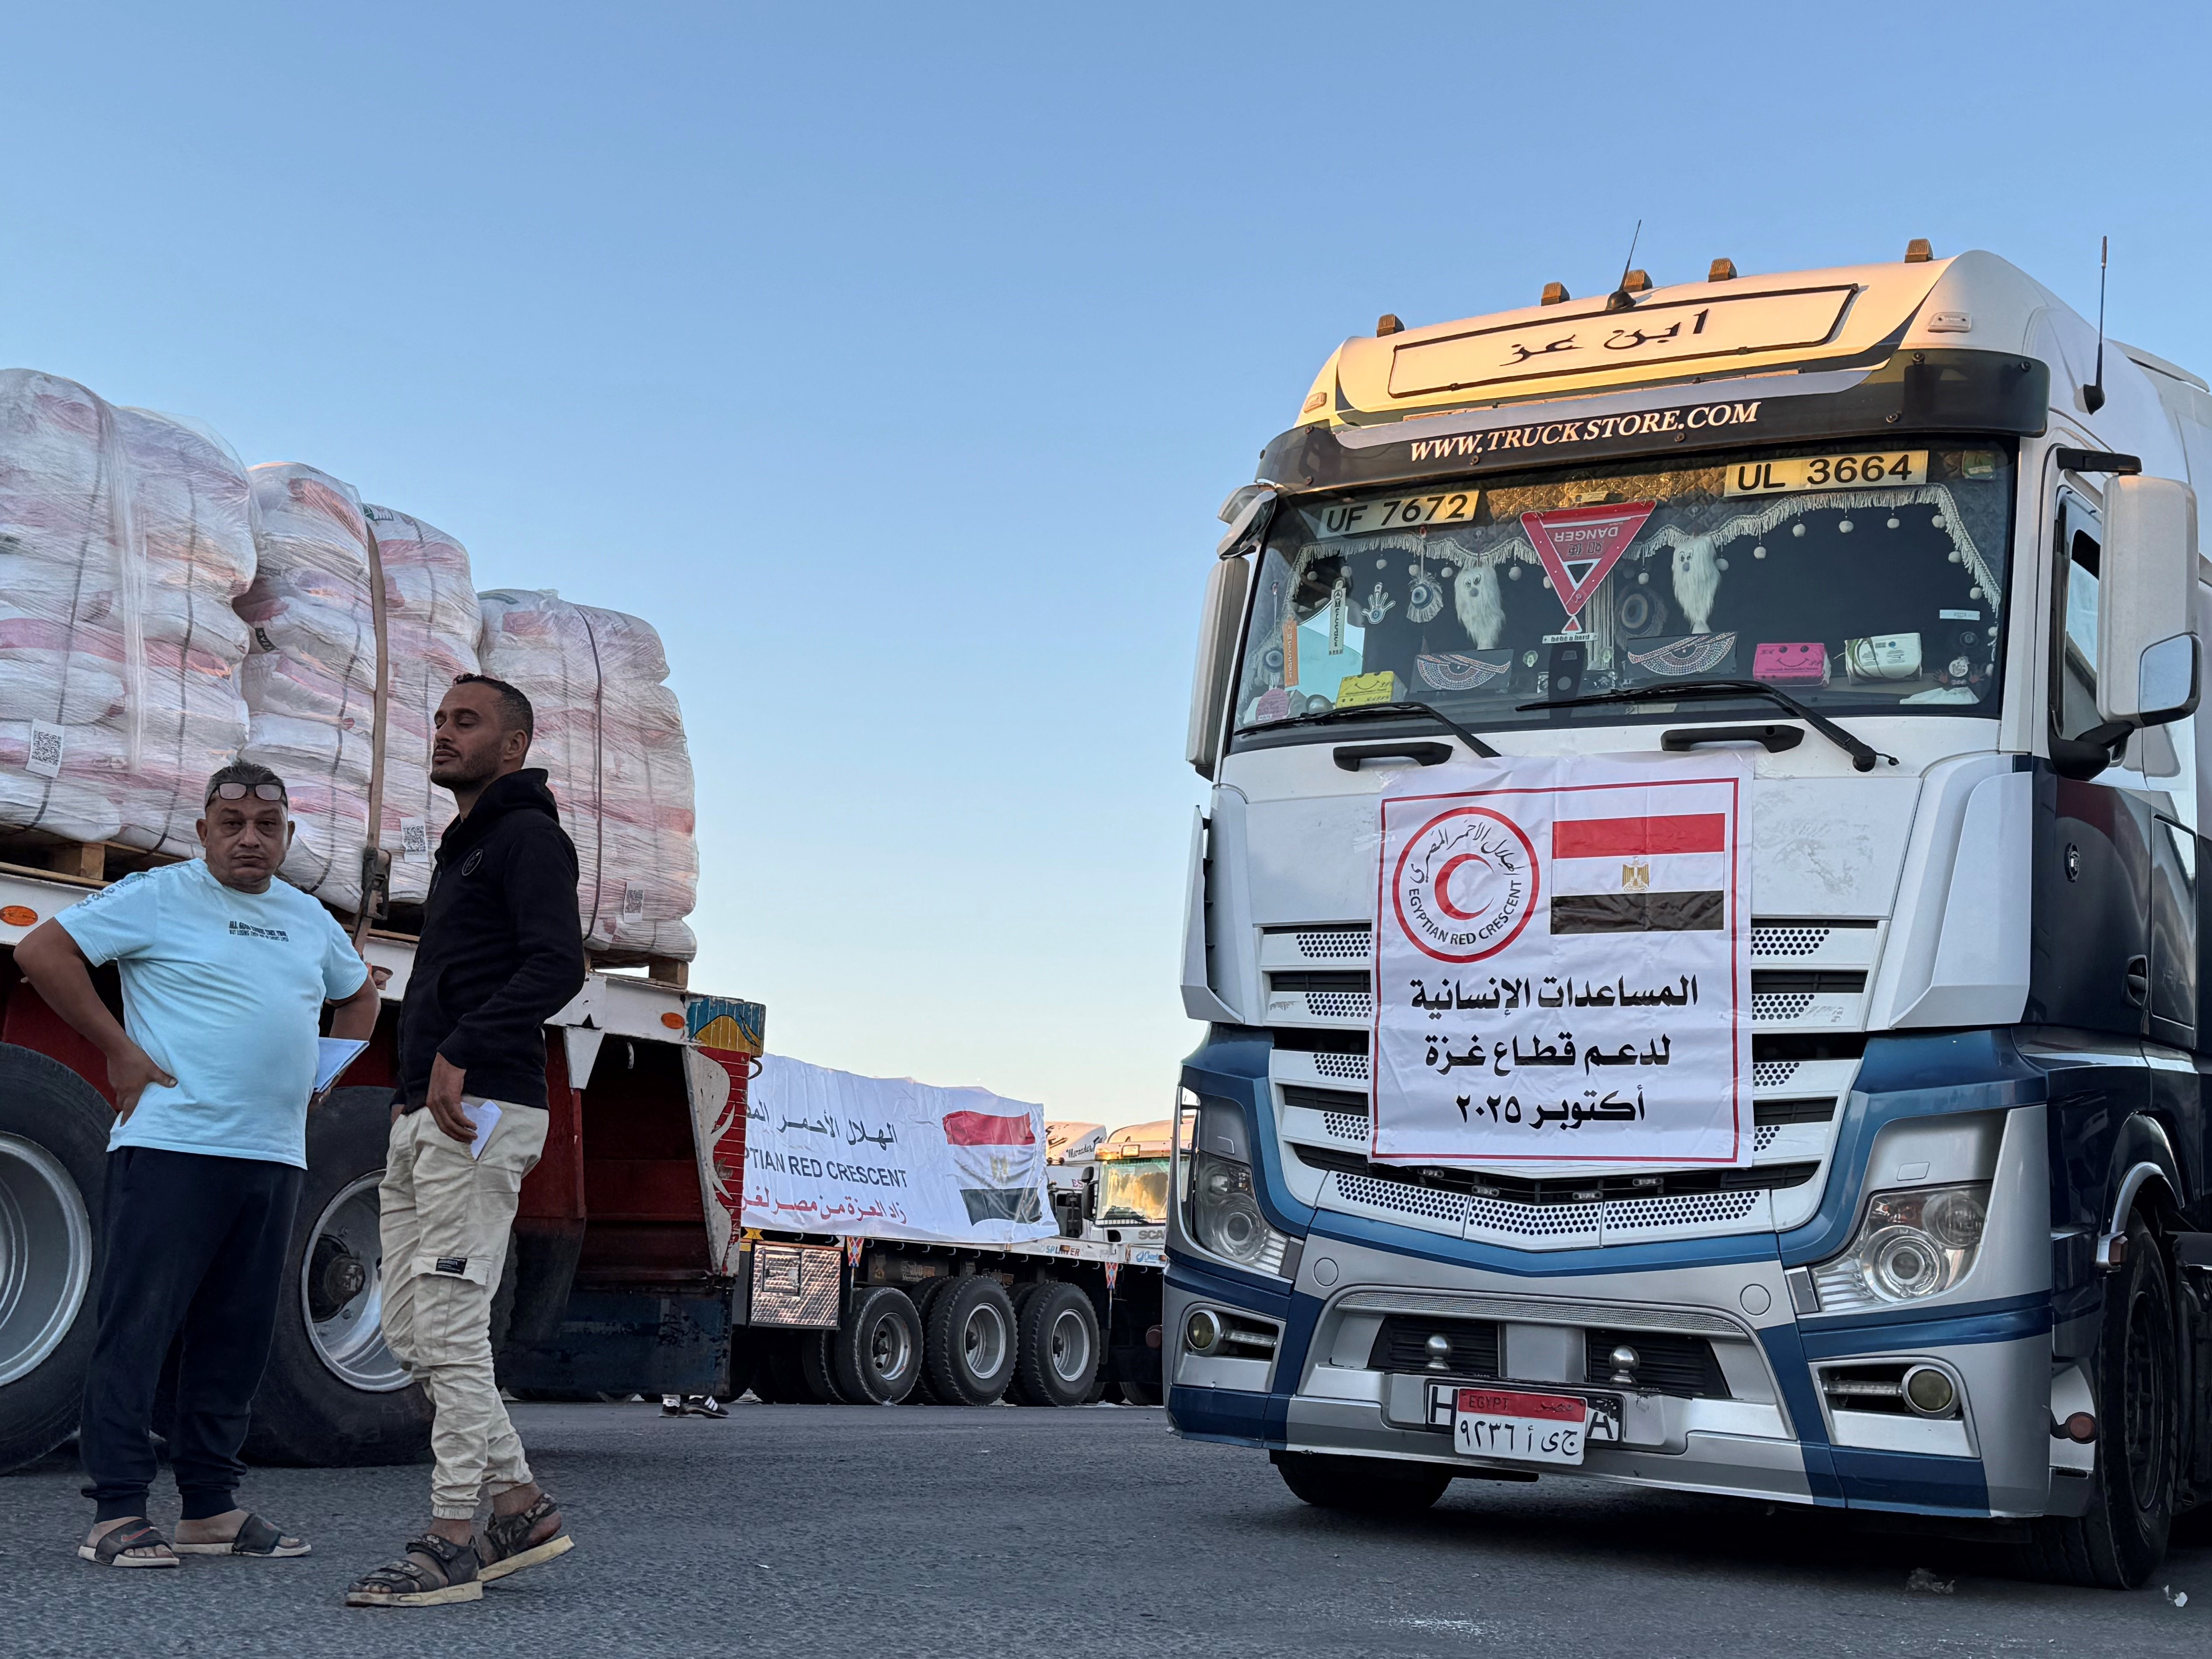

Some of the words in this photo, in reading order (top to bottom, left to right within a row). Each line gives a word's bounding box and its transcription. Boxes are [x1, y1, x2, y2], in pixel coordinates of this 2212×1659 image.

[1604, 308, 1710, 350] ابن
[1499, 334, 1585, 366] عز
[1738, 464, 1786, 491] UL
[1807, 454, 1912, 485] 3664
[1327, 505, 1368, 532] UF
[1381, 494, 1468, 526] 7672
[1555, 526, 1619, 542] DANGER
[1409, 888, 1449, 942] EGYPTIAN
[1450, 932, 1476, 945] RED
[1479, 880, 1521, 939] CRESCENT
[1410, 977, 1531, 1020] الإنسانية
[1538, 974, 1698, 1008] المساعدات
[1425, 1034, 1486, 1075] غزة
[1494, 1031, 1576, 1077] قطاع
[1585, 1033, 1671, 1076] لدعم
[777, 1109, 840, 1138] الأحمر
[1456, 1094, 1521, 1124] ٢٠٢٥
[1528, 1084, 1646, 1131] أكتوبر
[846, 1118, 898, 1151] الهلال
[788, 1155, 823, 1178] RED
[827, 1161, 907, 1188] CRESCENT
[771, 1198, 817, 1215] مصر
[817, 1195, 845, 1219] من
[845, 1195, 888, 1221] العزة
[889, 1201, 907, 1225] زاد
[1138, 1230, 1165, 1240] SCA
[1469, 1395, 1510, 1410] EGYPT
